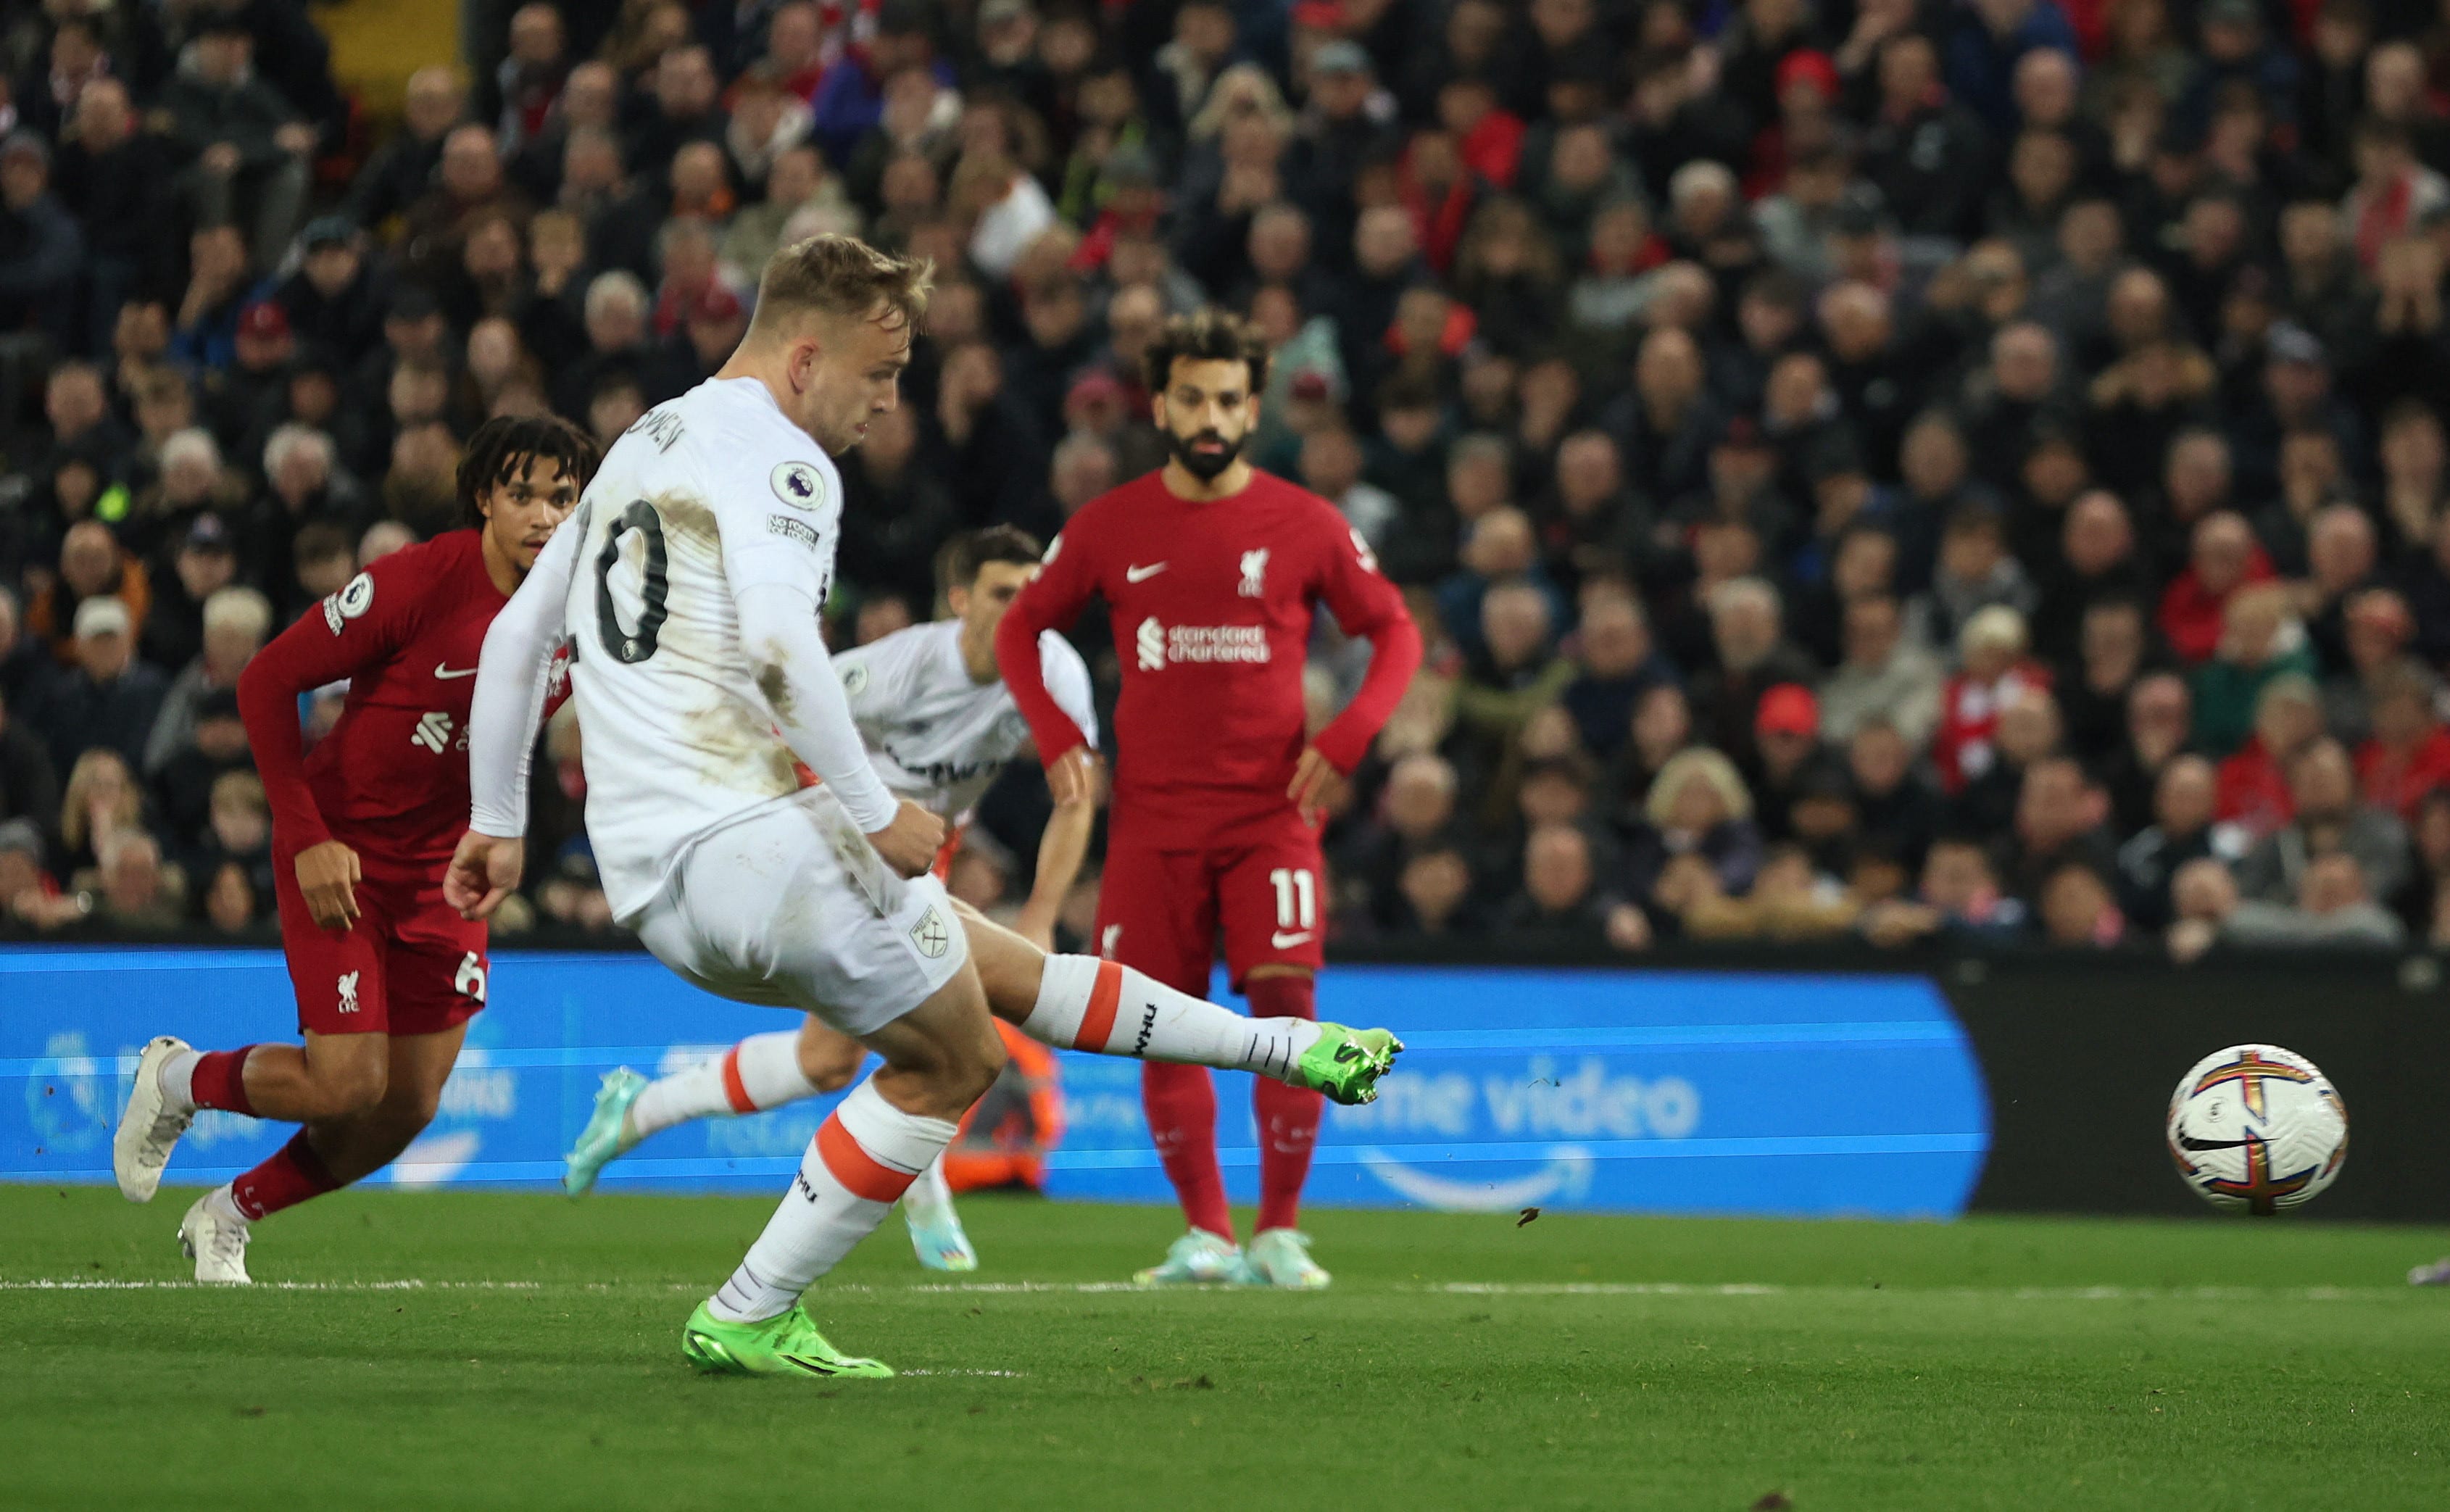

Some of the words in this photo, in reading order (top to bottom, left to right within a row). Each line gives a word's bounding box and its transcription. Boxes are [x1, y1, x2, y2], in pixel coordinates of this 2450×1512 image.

[568, 499, 668, 662] 0
[1270, 868, 1316, 929] 11
[454, 950, 490, 1002] 6
[1484, 1052, 1701, 1137] video
